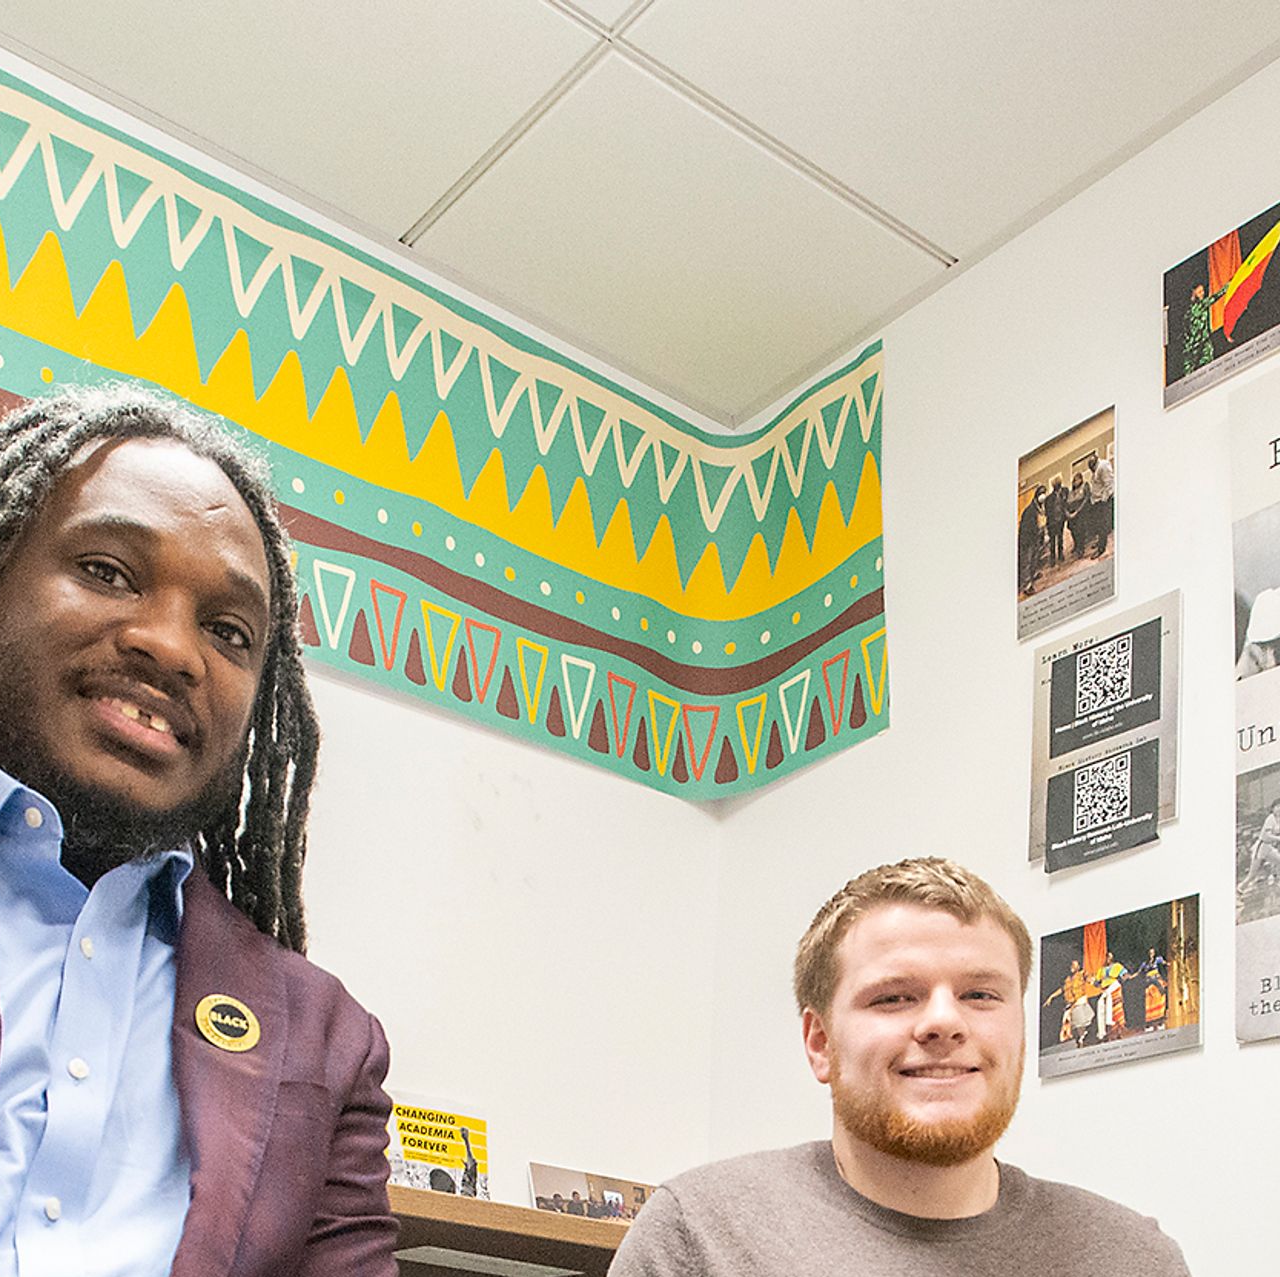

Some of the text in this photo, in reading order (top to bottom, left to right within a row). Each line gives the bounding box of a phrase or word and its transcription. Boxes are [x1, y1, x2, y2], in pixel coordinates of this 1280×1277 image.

[209, 1010, 250, 1030] BLACK
[395, 1106, 456, 1126] CHANGING
[399, 1122, 456, 1141] ACADEMIA
[402, 1136, 448, 1153] FOREVER
